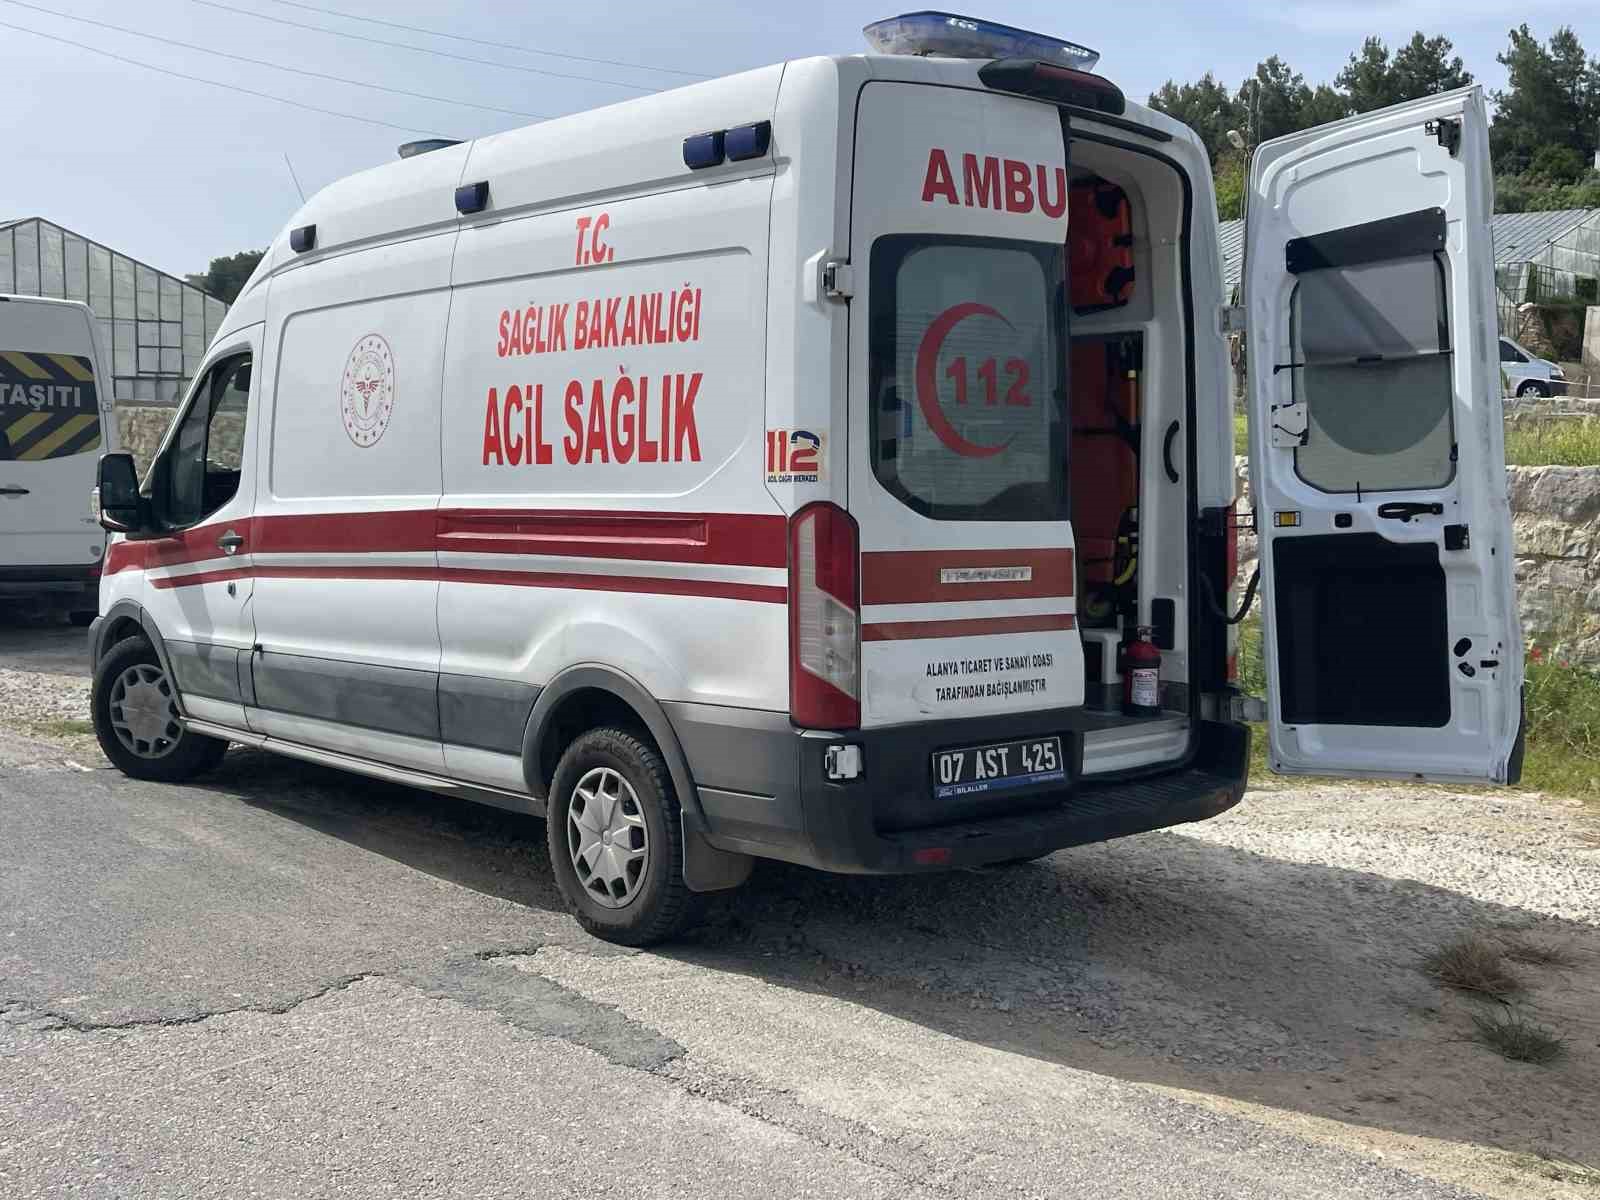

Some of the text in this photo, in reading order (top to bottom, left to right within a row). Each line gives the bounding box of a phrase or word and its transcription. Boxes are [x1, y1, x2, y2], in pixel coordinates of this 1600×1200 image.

[921, 148, 1066, 218] AMBU
[576, 213, 614, 265] T.C.
[497, 281, 702, 357] SAĞLIK BAKANLIĞI
[945, 357, 1032, 407] 112
[563, 365, 703, 465] SAĞLIK
[767, 431, 820, 472] 112
[926, 662, 959, 677] ALANYA
[994, 657, 1004, 671] VE
[1032, 653, 1053, 667] ODASI
[935, 684, 985, 702] TARAFINDAN
[940, 742, 1056, 784] 07 AST 425
